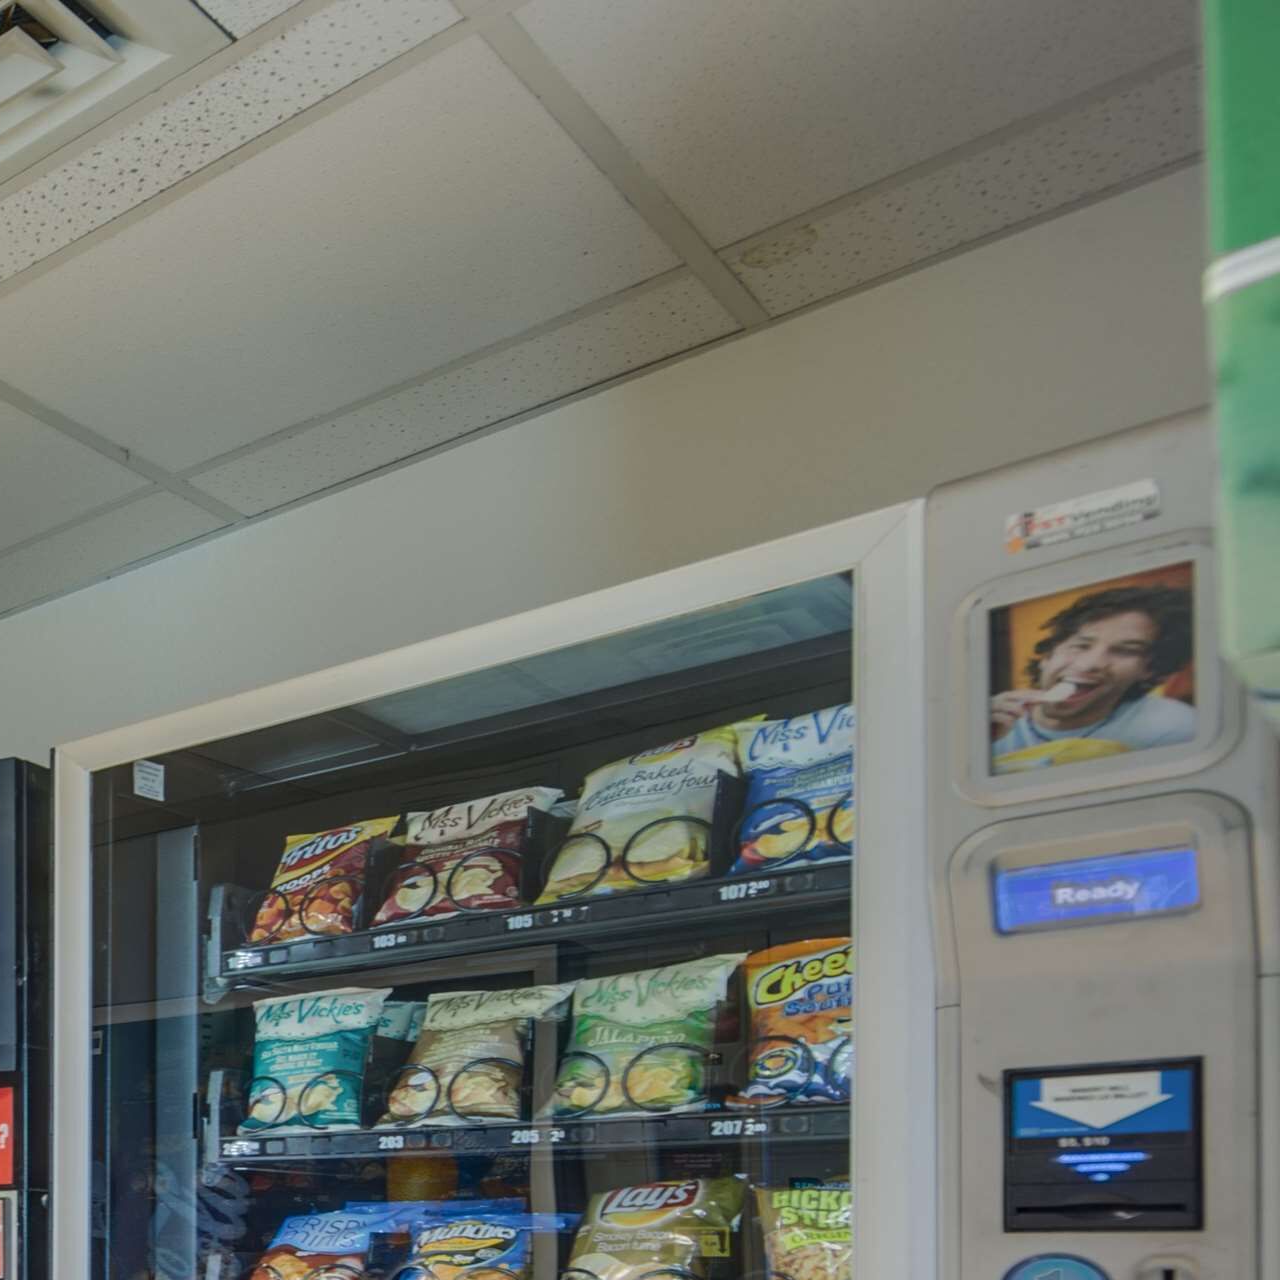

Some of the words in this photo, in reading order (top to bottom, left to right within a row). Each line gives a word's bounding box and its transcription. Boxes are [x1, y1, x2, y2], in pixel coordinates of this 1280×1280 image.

[812, 703, 855, 744] Vic
[1052, 876, 1140, 907] Ready
[711, 1121, 742, 1137] 207
